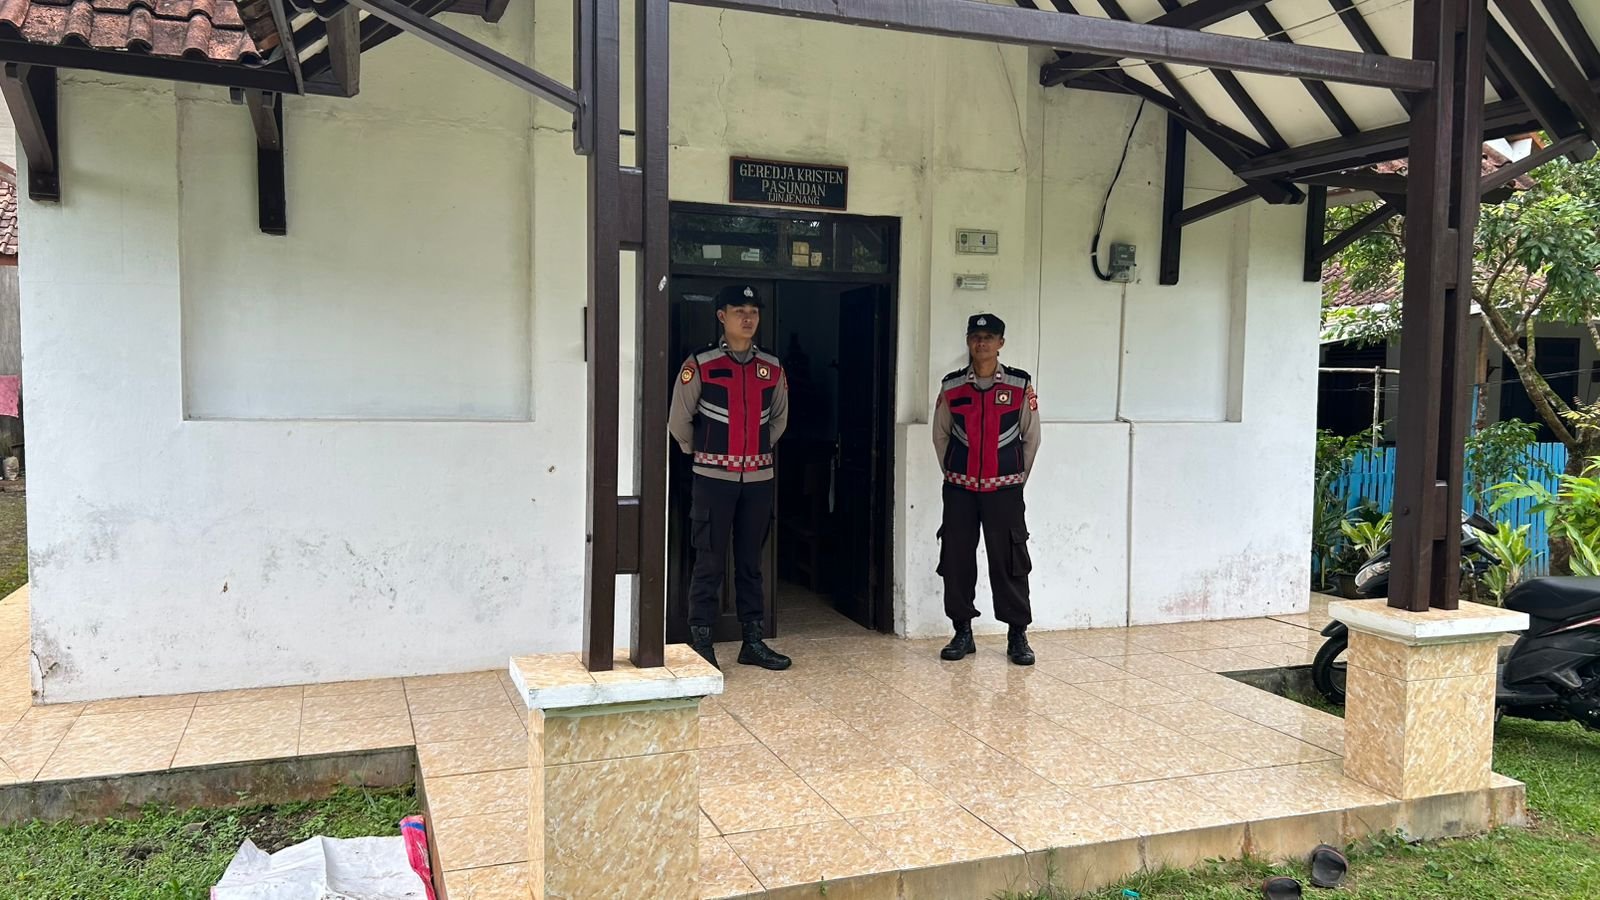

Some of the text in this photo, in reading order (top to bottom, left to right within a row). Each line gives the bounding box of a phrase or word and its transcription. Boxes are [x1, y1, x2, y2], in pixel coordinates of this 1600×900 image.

[739, 163, 843, 184] GEREDJA KRISTEN
[761, 179, 826, 197] PASUNDAN
